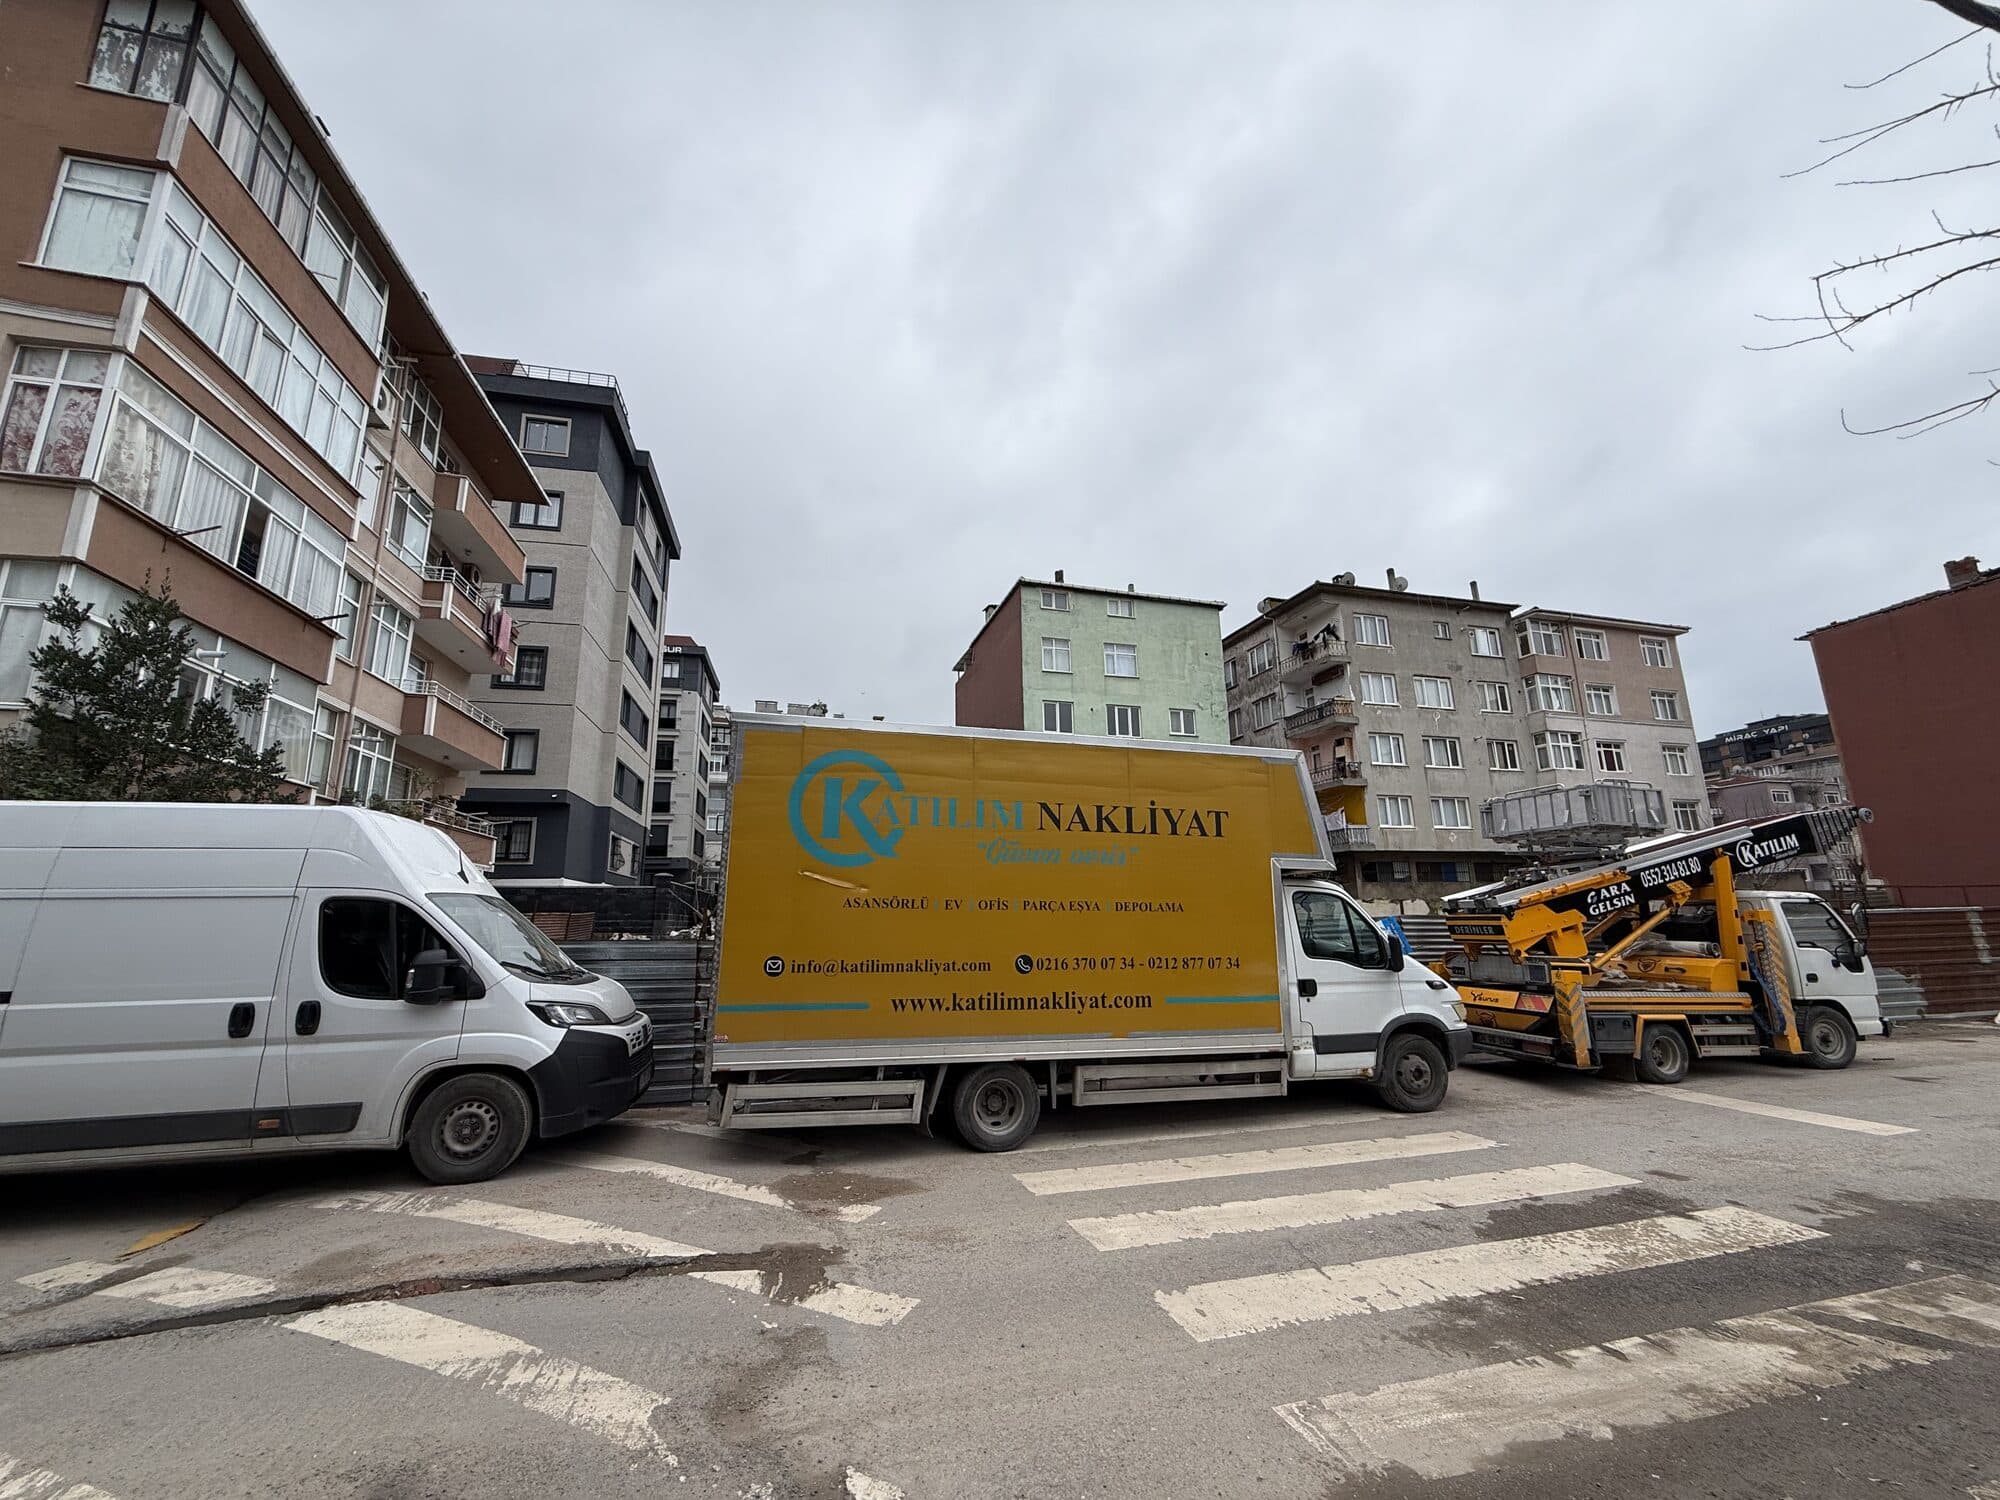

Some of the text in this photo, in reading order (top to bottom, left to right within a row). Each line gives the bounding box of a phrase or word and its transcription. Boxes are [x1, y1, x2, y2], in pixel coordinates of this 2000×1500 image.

[818, 775, 1229, 858] KATILIM NAKLİYAT
[1738, 833, 1800, 866] KATILIM
[1640, 856, 1702, 888] 0552 314 81 80
[1600, 882, 1631, 900] ARA
[842, 896, 1184, 913] ASANSÖRLÜ EV OFİS PARÇA EŞYA DEPOLAMA
[1589, 893, 1636, 916] GELSİN
[791, 959, 991, 977] info@katilimnakliyat.com
[1036, 957, 1068, 971] 0216
[1072, 957, 1096, 971] 370
[1100, 957, 1115, 971] 07
[1119, 957, 1135, 970] 34
[1148, 957, 1178, 970] 0212
[1182, 957, 1204, 970] 877
[1207, 957, 1222, 970] 07
[1226, 957, 1241, 970] 34
[890, 991, 1153, 1014] www.katilimnakliyat.com
